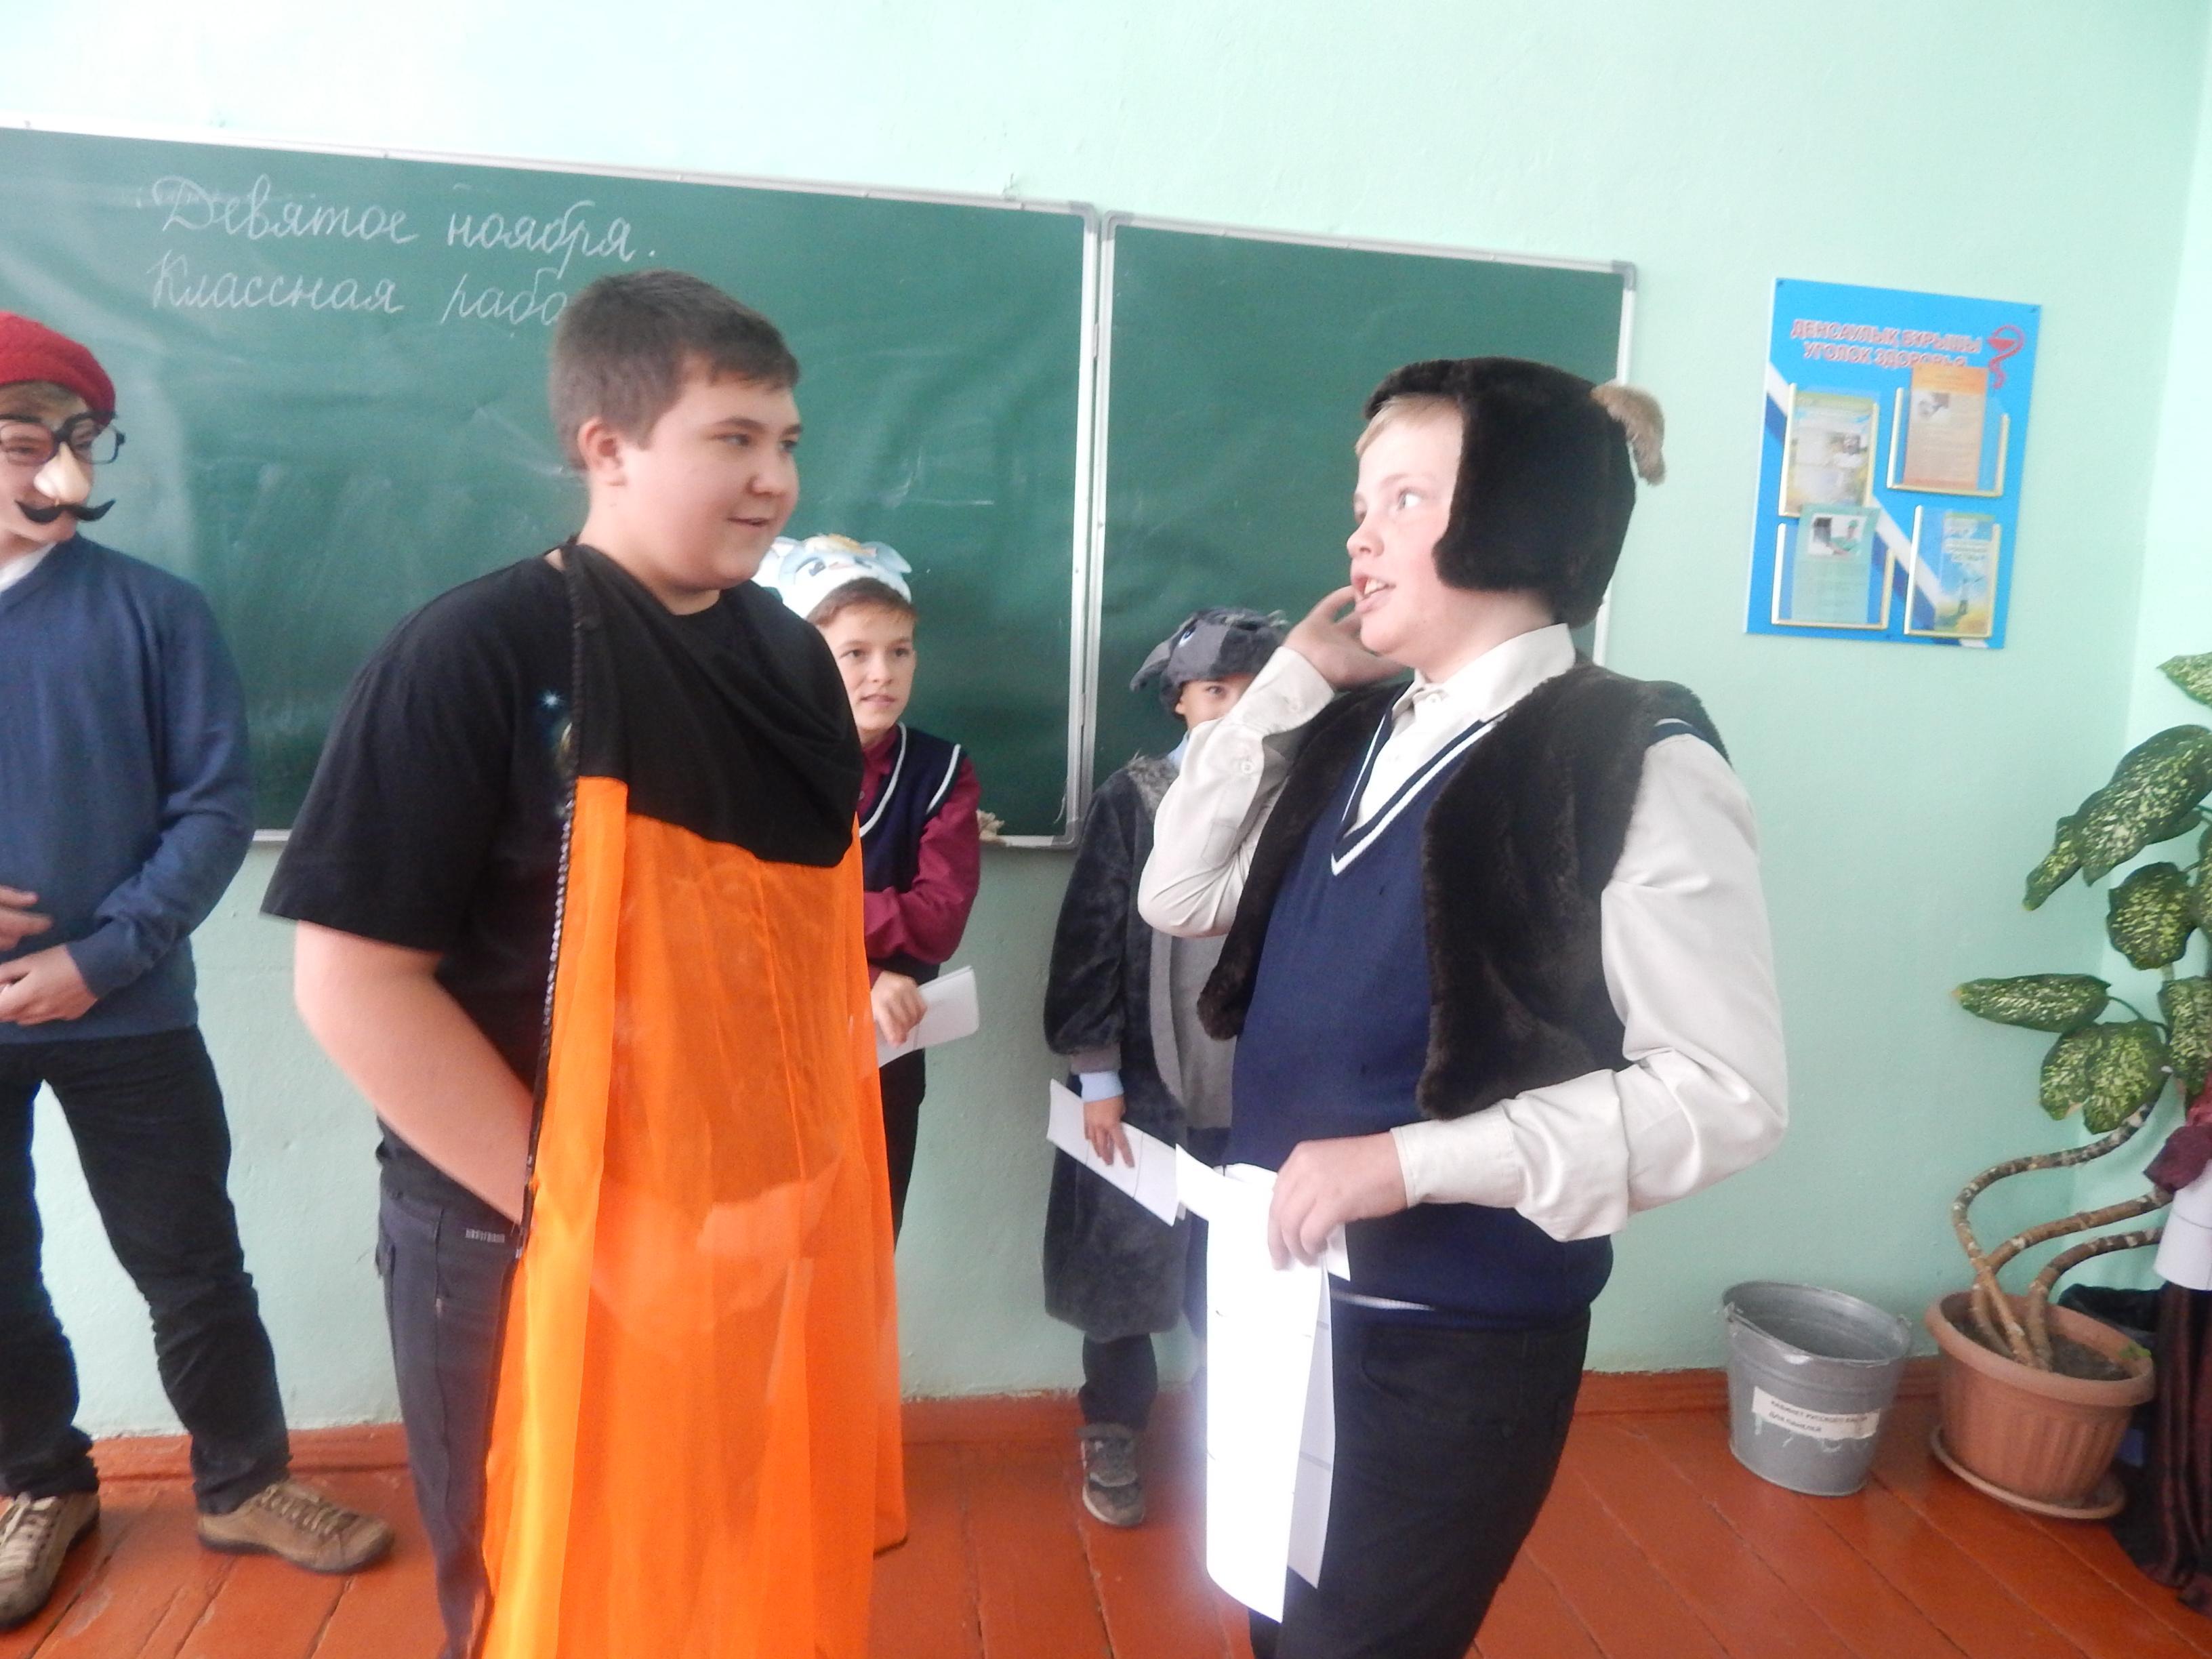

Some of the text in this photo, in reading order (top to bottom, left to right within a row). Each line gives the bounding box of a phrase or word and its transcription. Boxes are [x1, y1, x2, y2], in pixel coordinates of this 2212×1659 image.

[152, 173, 655, 280] Девятое ноября.
[146, 249, 567, 325] Классная рабо
[1803, 342, 1872, 364] УГОЛОК
